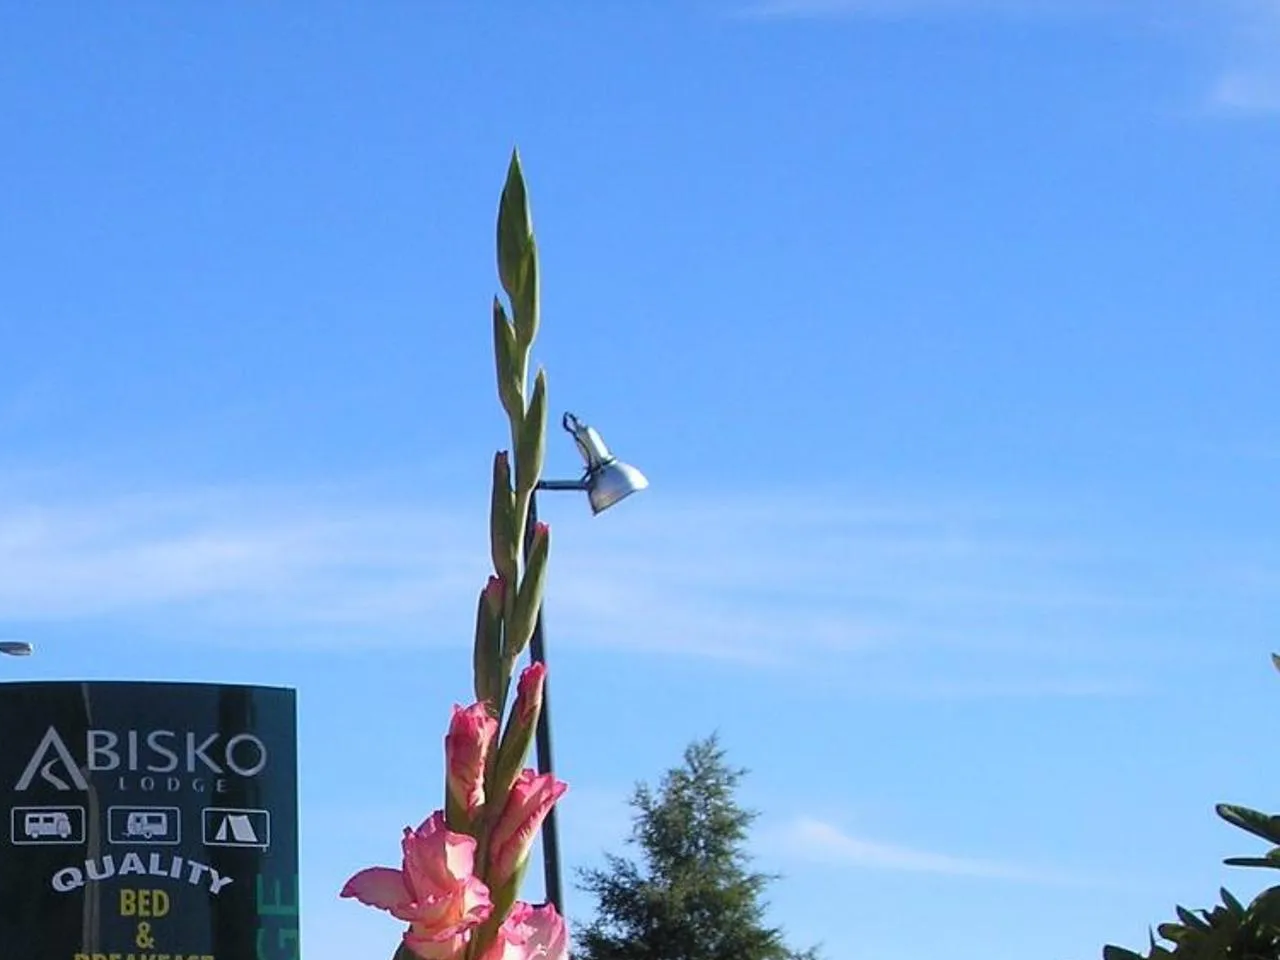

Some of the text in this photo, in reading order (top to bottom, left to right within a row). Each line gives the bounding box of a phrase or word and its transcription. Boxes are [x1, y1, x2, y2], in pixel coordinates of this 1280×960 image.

[14, 726, 267, 790] ABISKO
[118, 777, 228, 793] LODGE
[51, 852, 233, 895] QUALITY
[120, 889, 169, 917] BED
[135, 921, 154, 948] &
